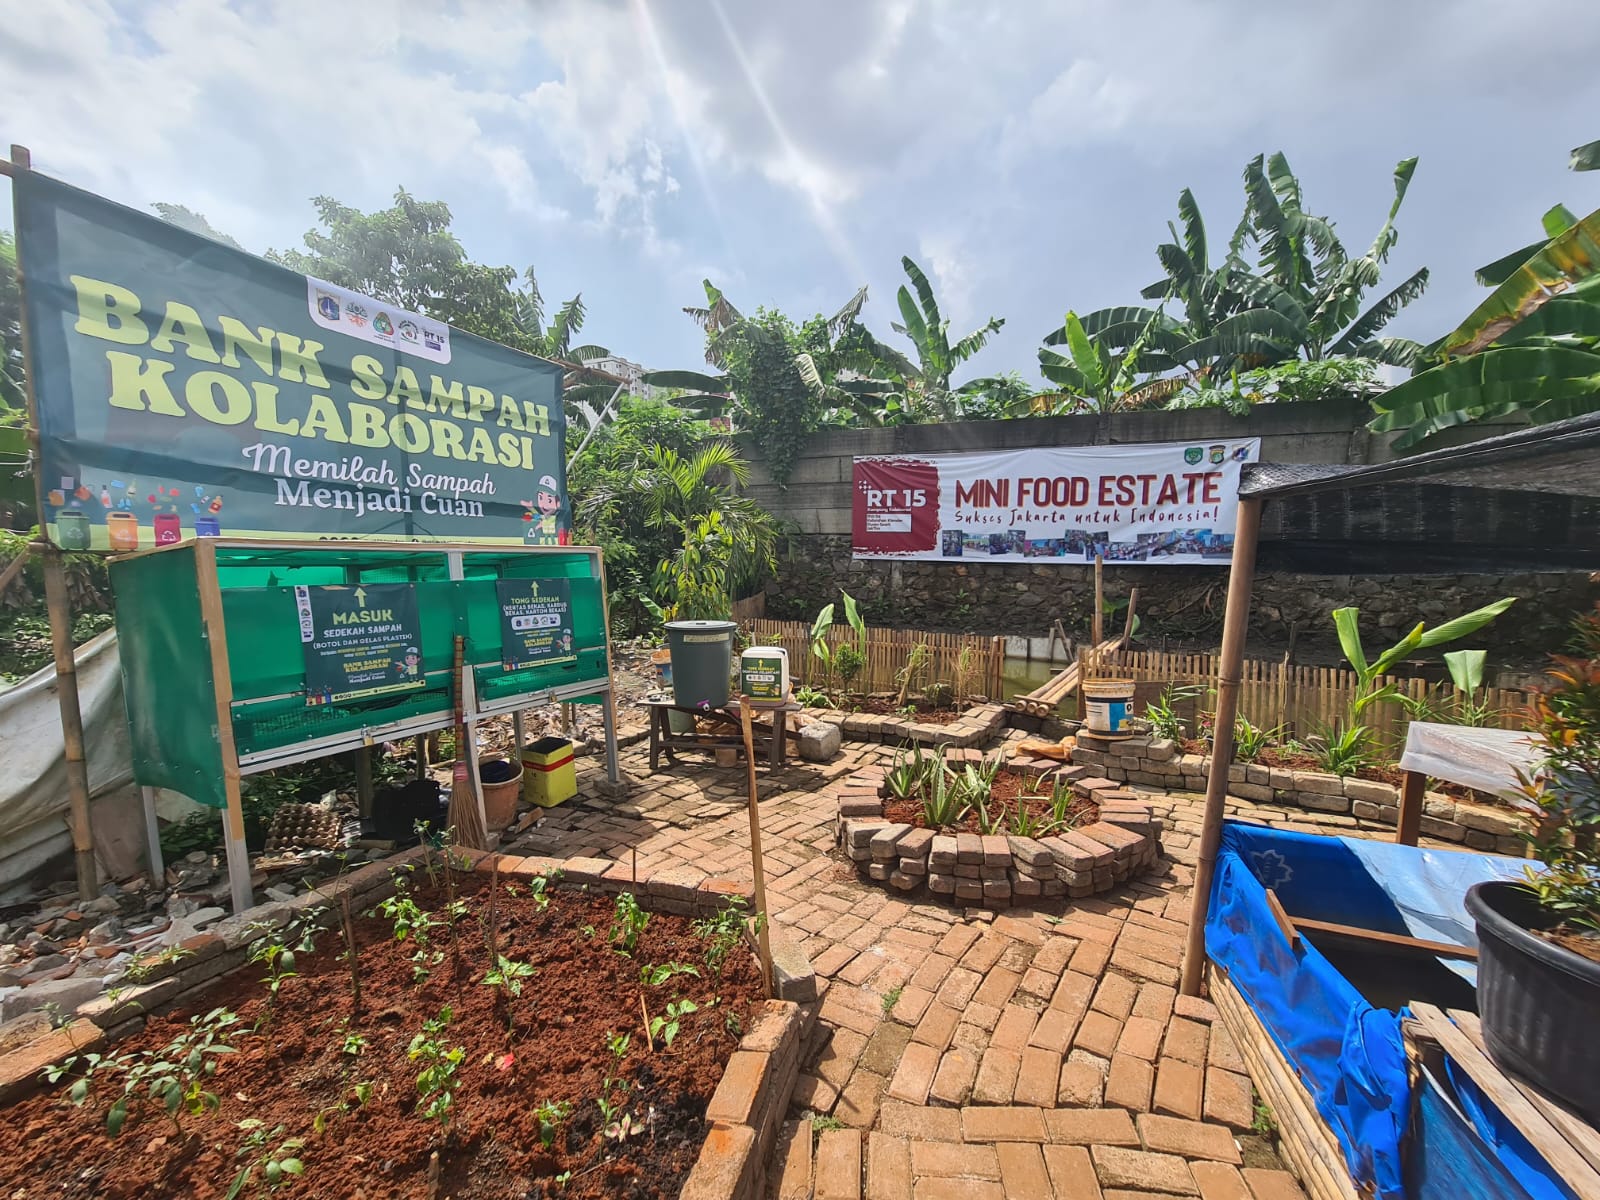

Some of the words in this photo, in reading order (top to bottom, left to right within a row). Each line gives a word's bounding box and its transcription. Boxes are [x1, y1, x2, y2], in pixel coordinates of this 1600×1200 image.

[70, 275, 331, 389] BANK
[351, 354, 551, 437] SAMPAH
[106, 350, 534, 470] KOLABORASI
[242, 442, 397, 486] Memilah
[406, 463, 497, 499] Sampah
[274, 478, 413, 517] Menjadi
[420, 491, 484, 517] Cuan
[867, 489, 897, 507] RT
[903, 489, 927, 507] 15
[955, 478, 1010, 509] MINI
[1017, 477, 1090, 508] FOOD
[1098, 471, 1223, 507] ESTATE
[954, 511, 1003, 526] Sukses
[1009, 508, 1066, 526] Jakarta
[1075, 509, 1120, 524] untuk
[1130, 505, 1219, 524] Indonesia!
[323, 626, 365, 638] SEDEKAH
[368, 623, 402, 634] SAMPAH
[333, 609, 393, 625] MASUK
[313, 641, 341, 650] (BOTOL
[343, 638, 358, 646] DAN
[360, 636, 382, 644] GELAS
[383, 633, 413, 642] PLASTIK)
